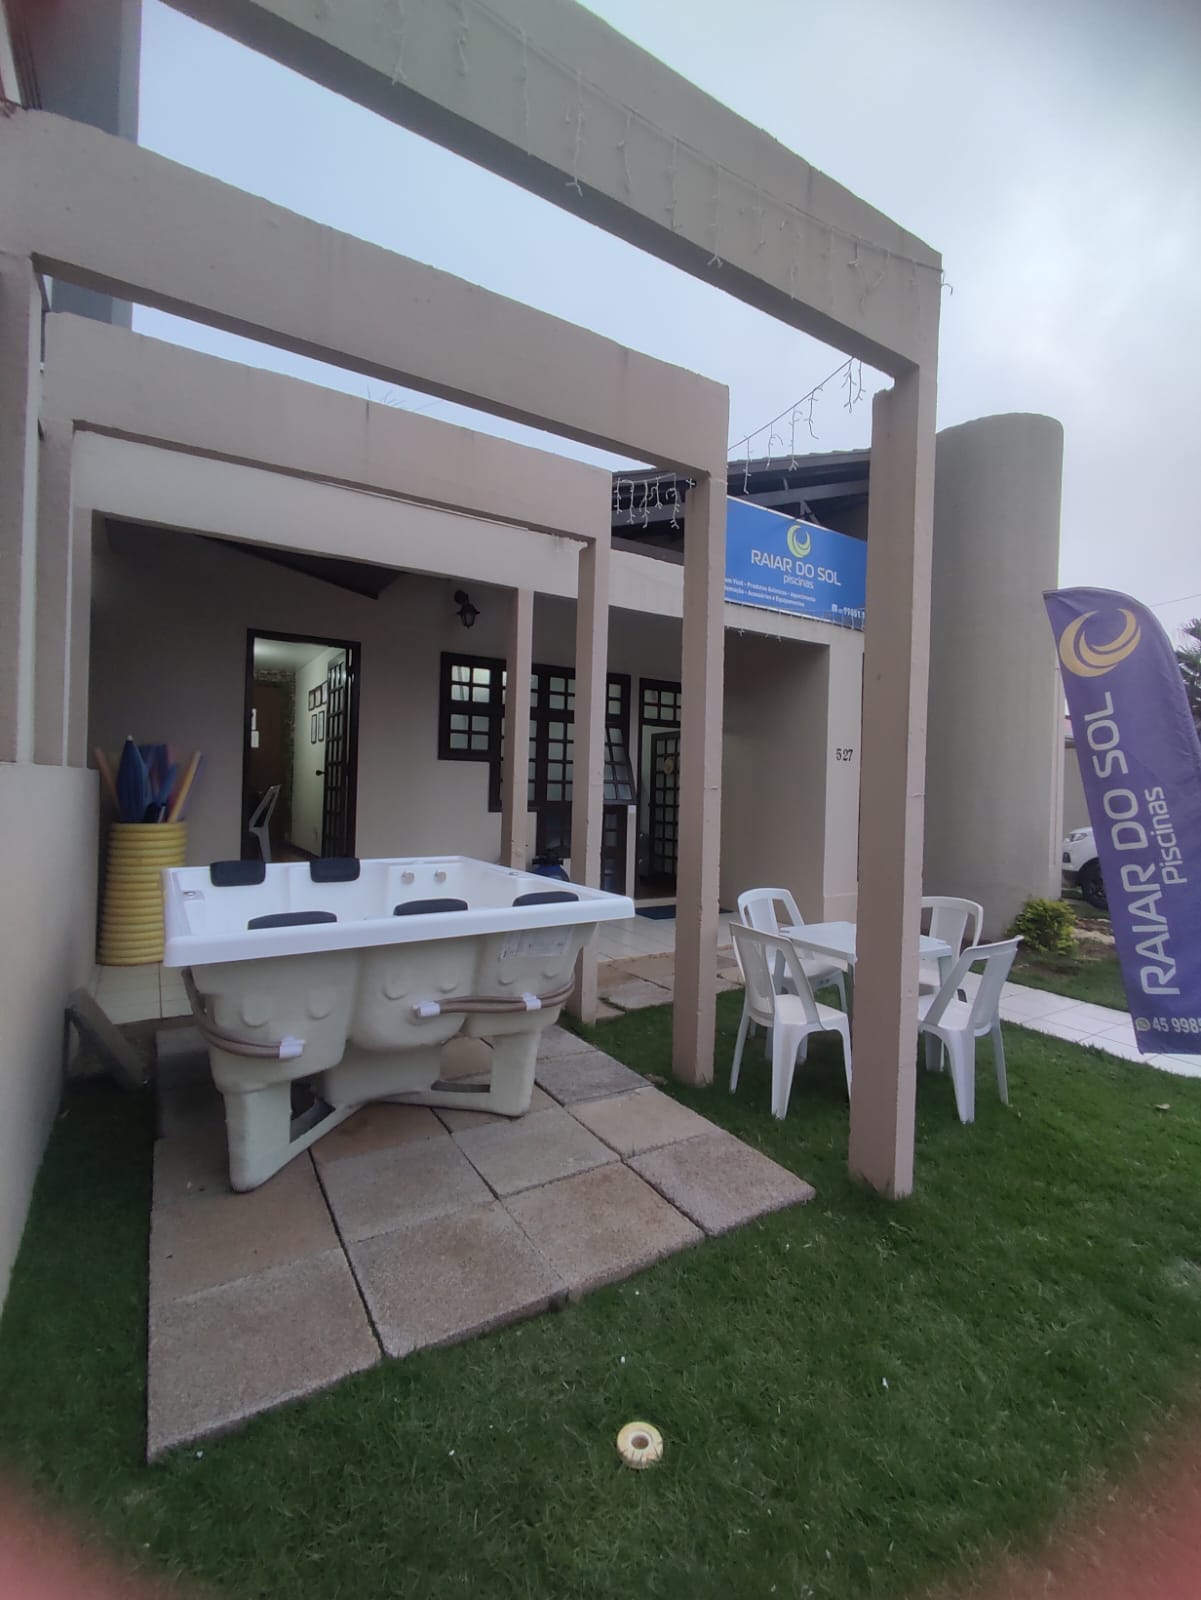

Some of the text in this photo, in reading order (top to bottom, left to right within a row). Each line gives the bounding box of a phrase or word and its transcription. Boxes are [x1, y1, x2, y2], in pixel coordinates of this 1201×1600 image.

[751, 549, 842, 586] RAIAR DO SOL
[783, 575, 815, 589] piscinas
[835, 748, 854, 761] 527
[1084, 691, 1181, 995] RAIAR DO SOL
[1152, 1016, 1169, 1033] 45
